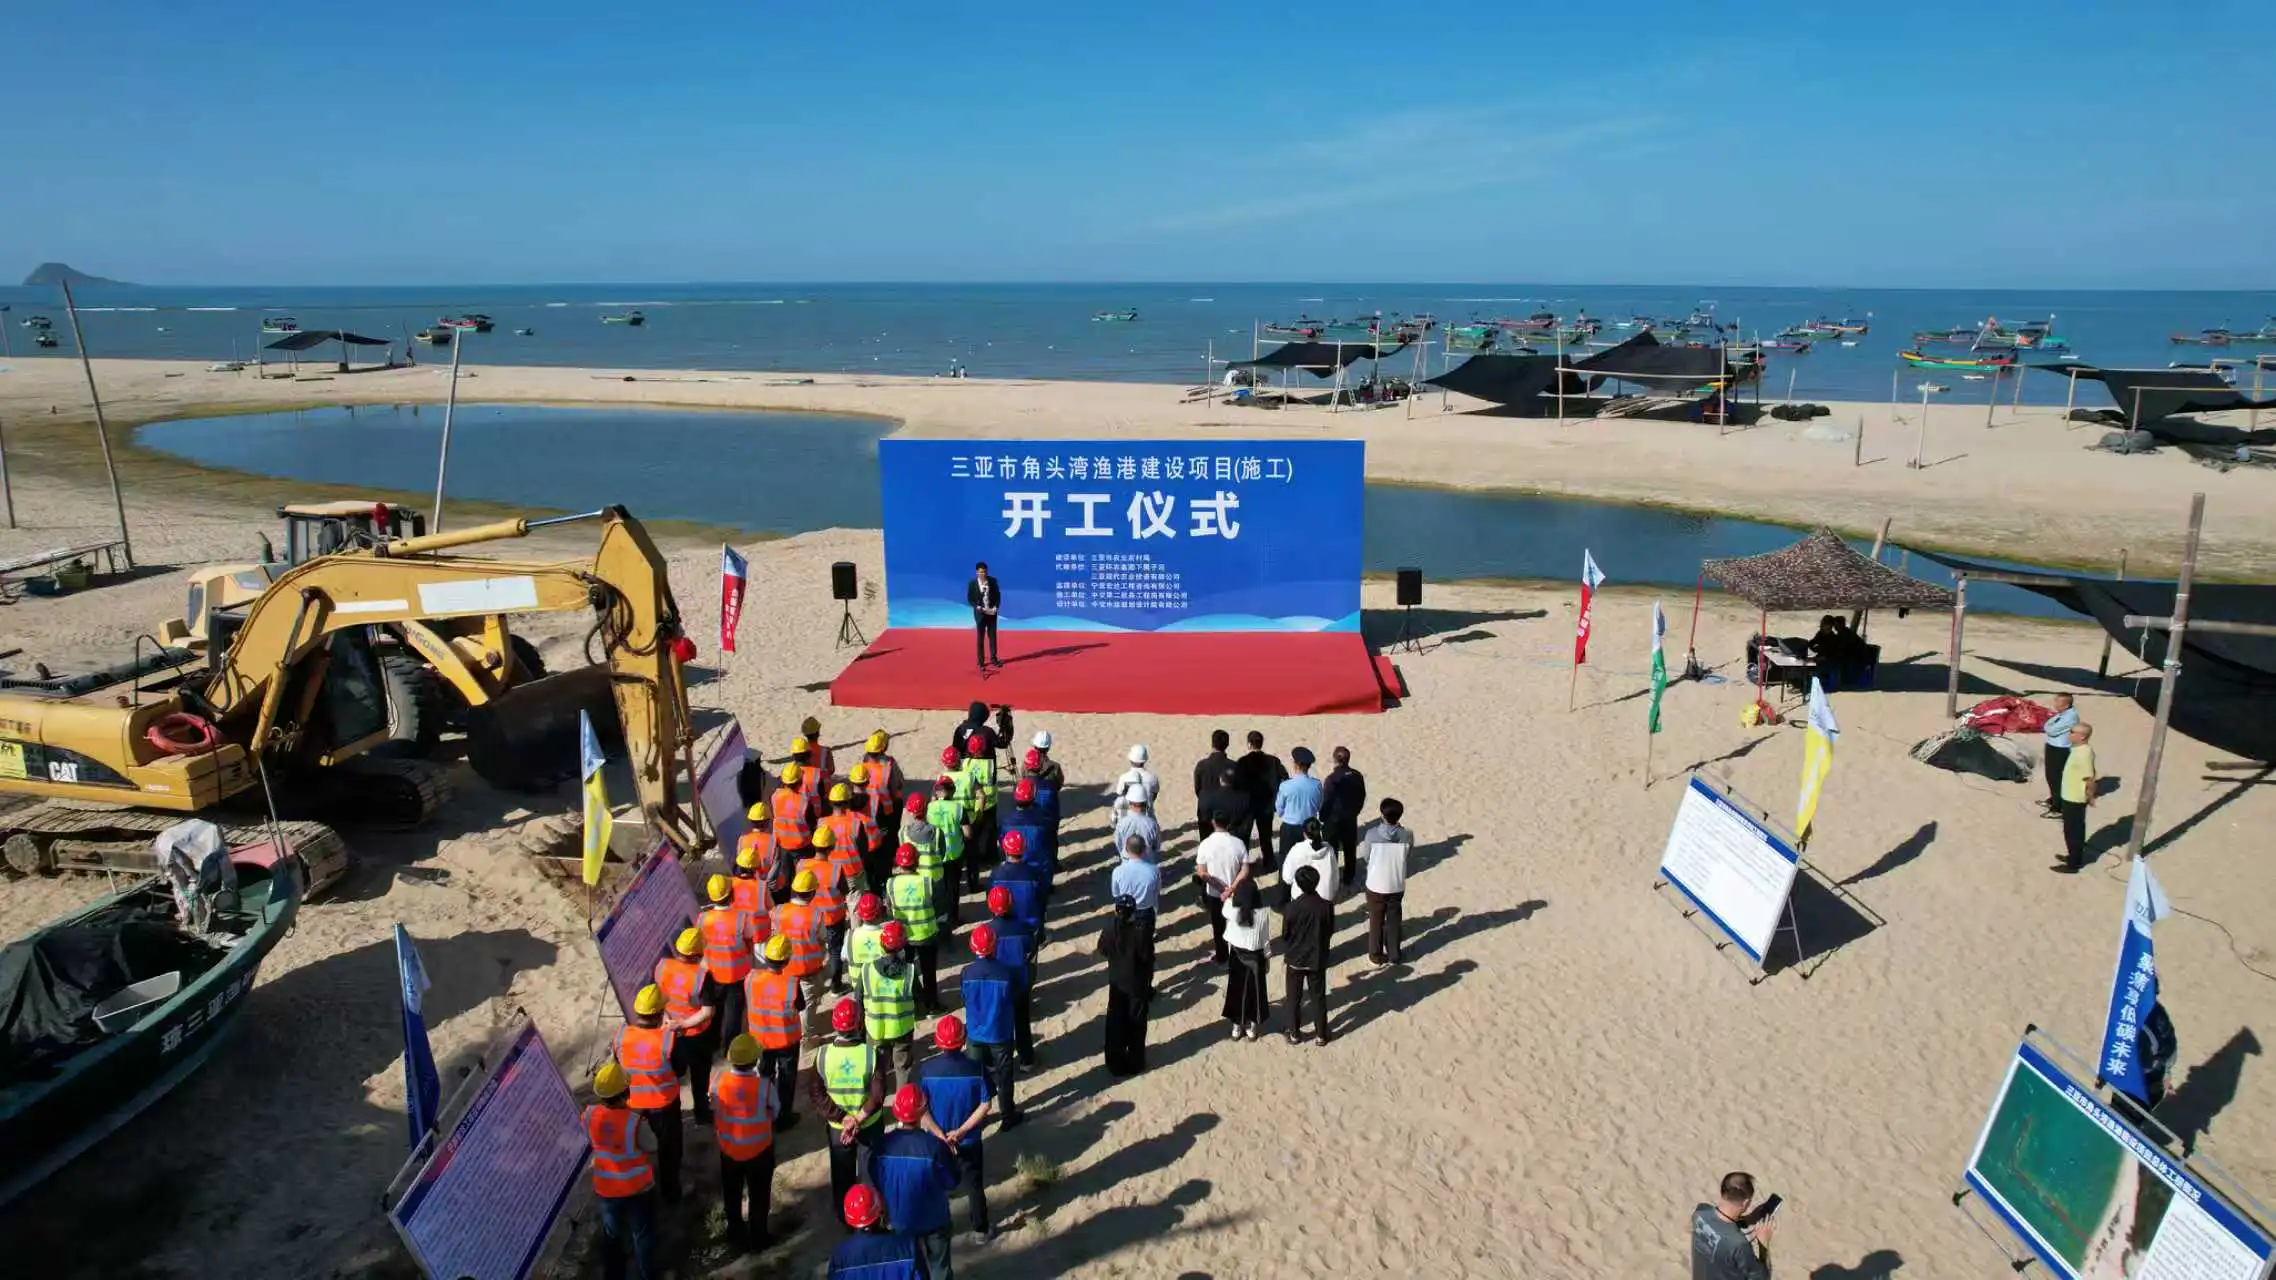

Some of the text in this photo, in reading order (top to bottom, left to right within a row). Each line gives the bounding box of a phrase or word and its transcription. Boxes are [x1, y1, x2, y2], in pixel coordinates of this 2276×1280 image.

[951, 456, 1293, 480] 三亚市角头湾渔港建设项目(施工)
[1002, 490, 1240, 540] 开工仪式
[48, 761, 79, 783] CAT
